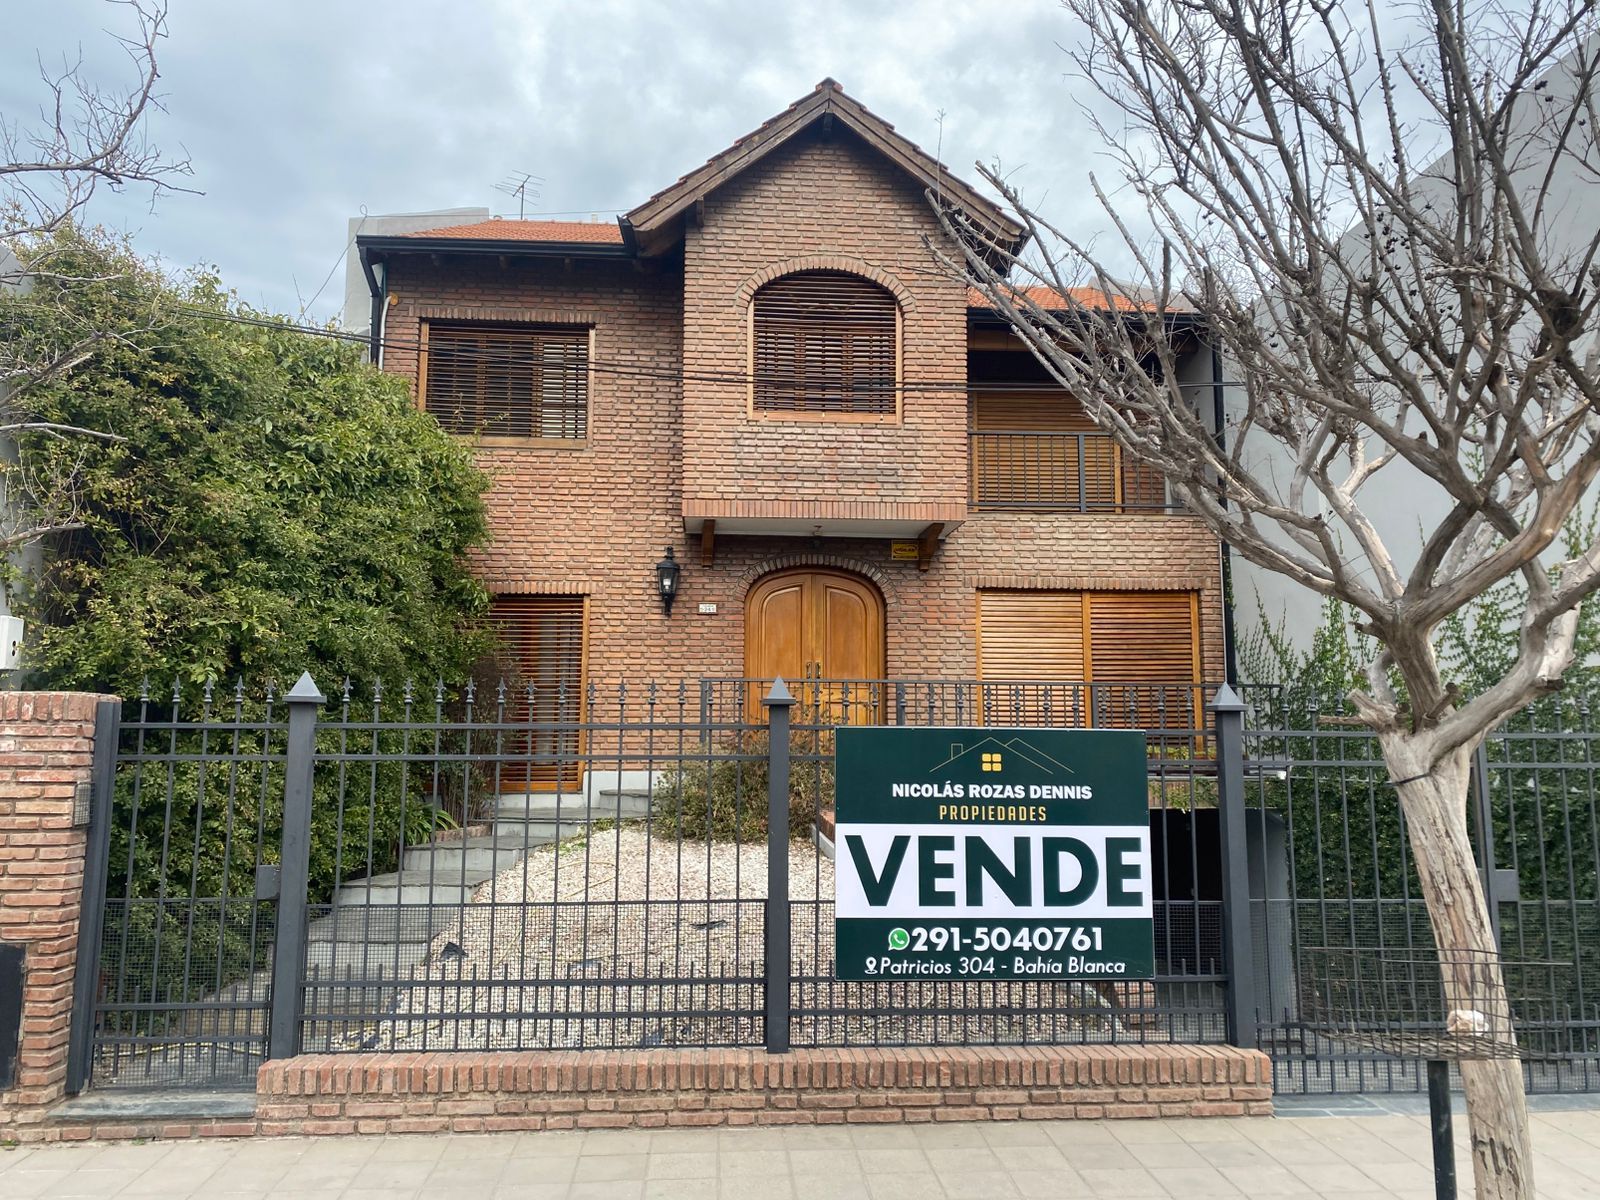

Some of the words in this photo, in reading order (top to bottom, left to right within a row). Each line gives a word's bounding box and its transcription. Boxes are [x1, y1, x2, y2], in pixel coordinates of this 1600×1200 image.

[892, 780, 965, 799] NICOLÁS
[969, 784, 1025, 799] ROZAS
[1029, 785, 1093, 800] DENNIS
[939, 805, 1047, 821] PROPIEDADES
[845, 835, 1143, 907] VENDE
[911, 927, 1102, 951] 291-5040761
[880, 957, 952, 974] Patricios
[958, 957, 995, 974] 304
[1013, 957, 1062, 974] Bahía
[1068, 957, 1126, 974] Blanca
